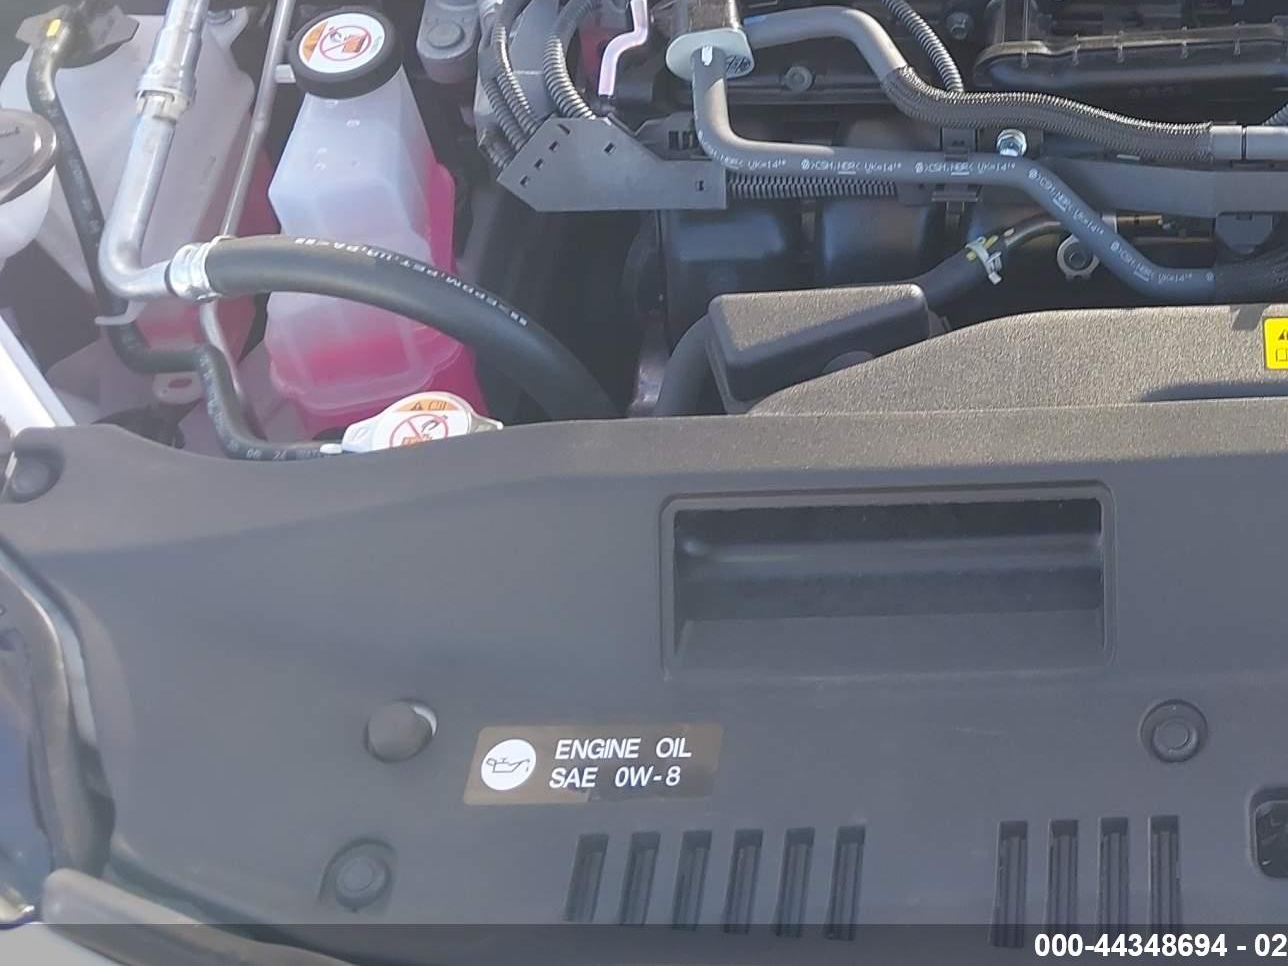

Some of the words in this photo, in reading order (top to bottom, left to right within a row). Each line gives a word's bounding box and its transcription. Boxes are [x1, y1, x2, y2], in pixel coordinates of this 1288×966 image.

[555, 738, 641, 759] ENGINE
[656, 738, 691, 757] OIL
[549, 768, 598, 788] SAE
[615, 766, 680, 787] 0W-8
